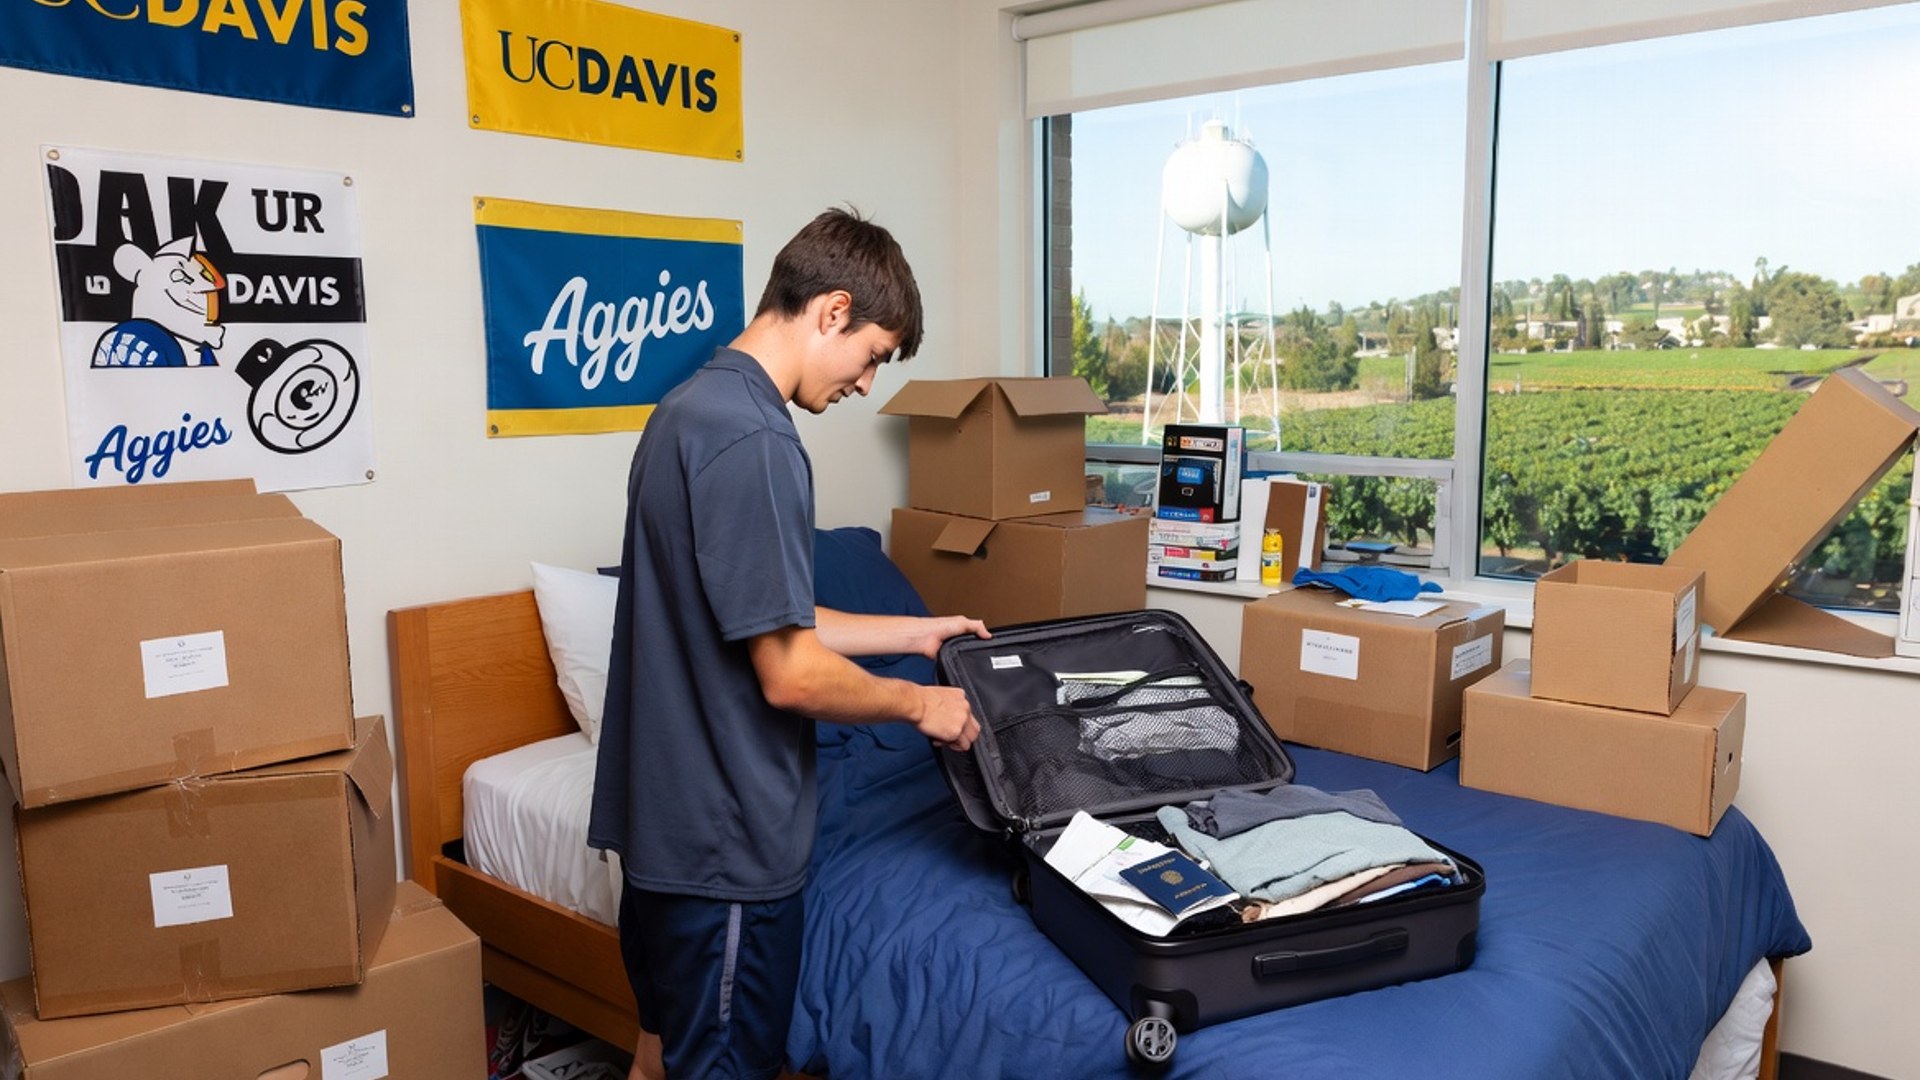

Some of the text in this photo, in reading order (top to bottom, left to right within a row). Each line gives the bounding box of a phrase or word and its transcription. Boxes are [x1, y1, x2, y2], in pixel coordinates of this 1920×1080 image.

[251, 188, 325, 234] UR
[226, 273, 341, 306] DAVIS
[524, 270, 714, 390] Aggies
[85, 413, 232, 484] Aggies
